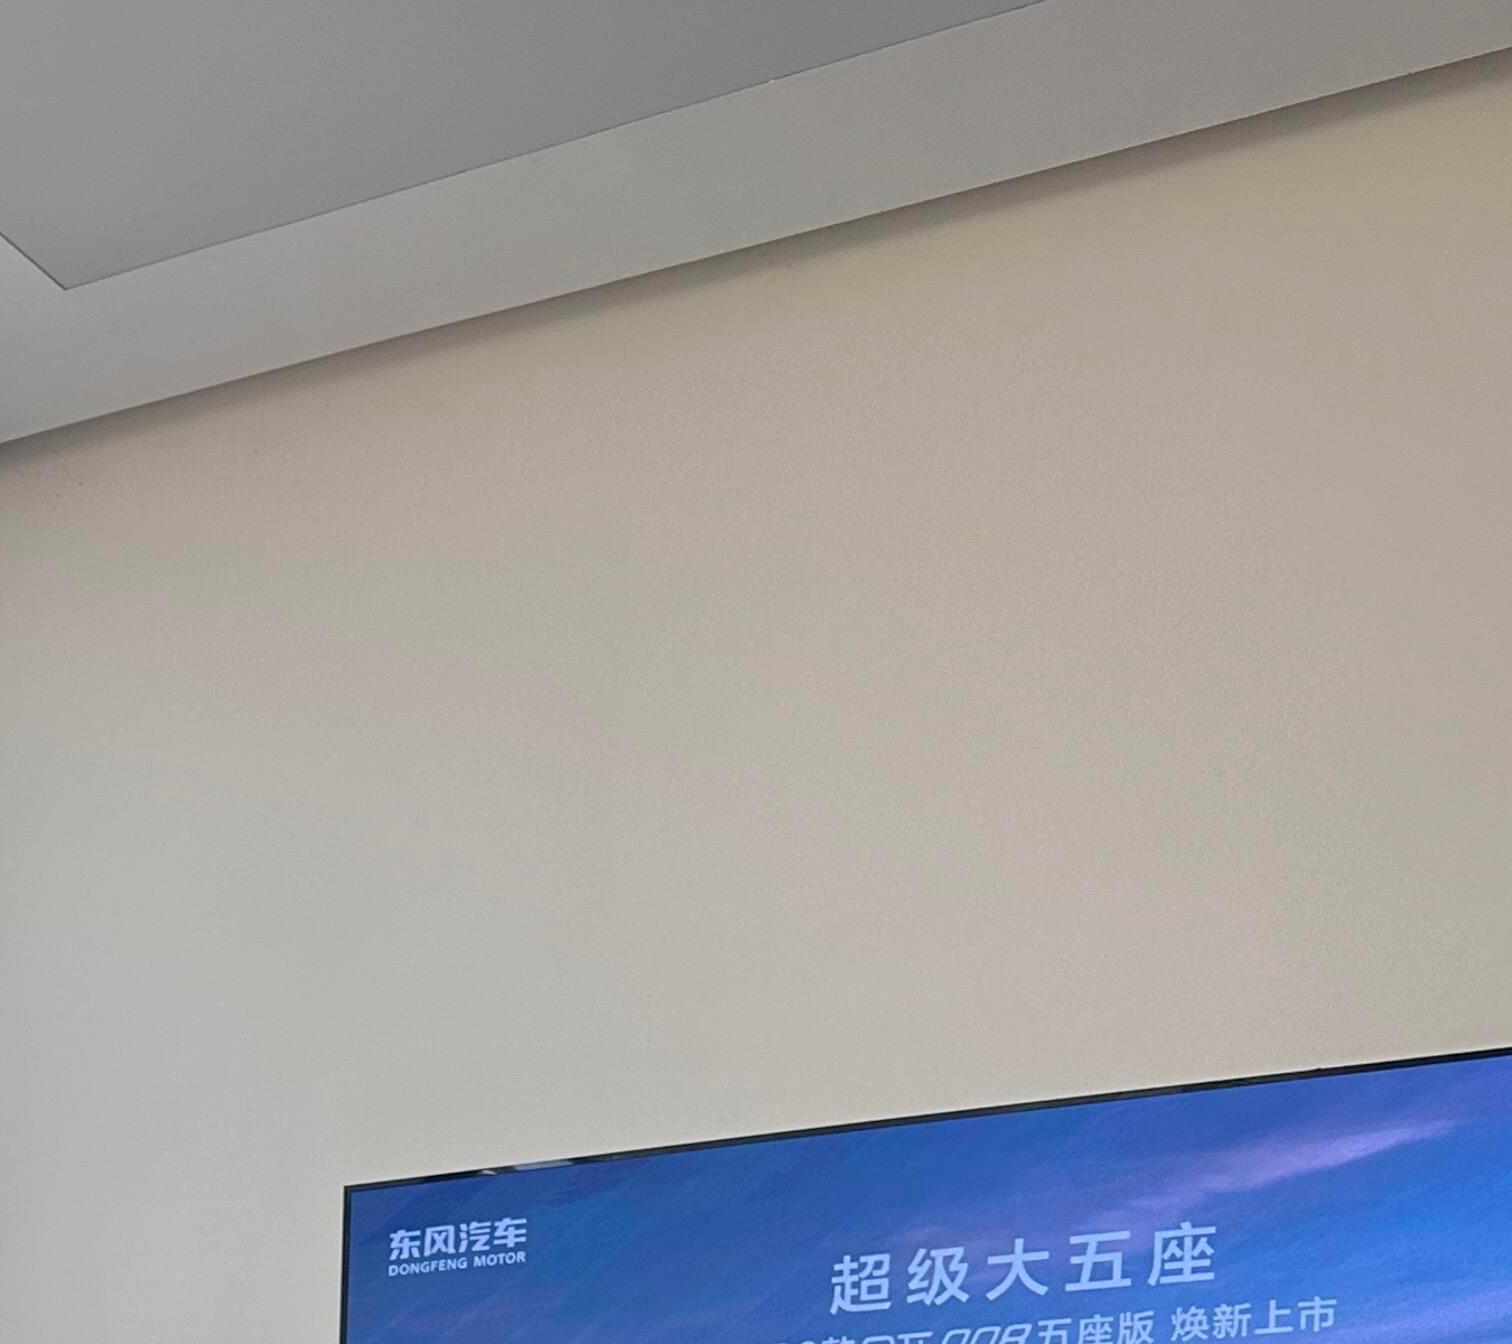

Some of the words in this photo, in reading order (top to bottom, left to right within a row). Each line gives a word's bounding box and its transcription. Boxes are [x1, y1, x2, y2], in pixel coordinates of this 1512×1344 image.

[389, 1216, 527, 1261] 东风汽车
[388, 1257, 467, 1277] DONGFENG
[473, 1250, 526, 1268] MOTOR
[830, 1221, 1218, 1317] 超级大五座
[1170, 1296, 1338, 1342] 焕新上市
